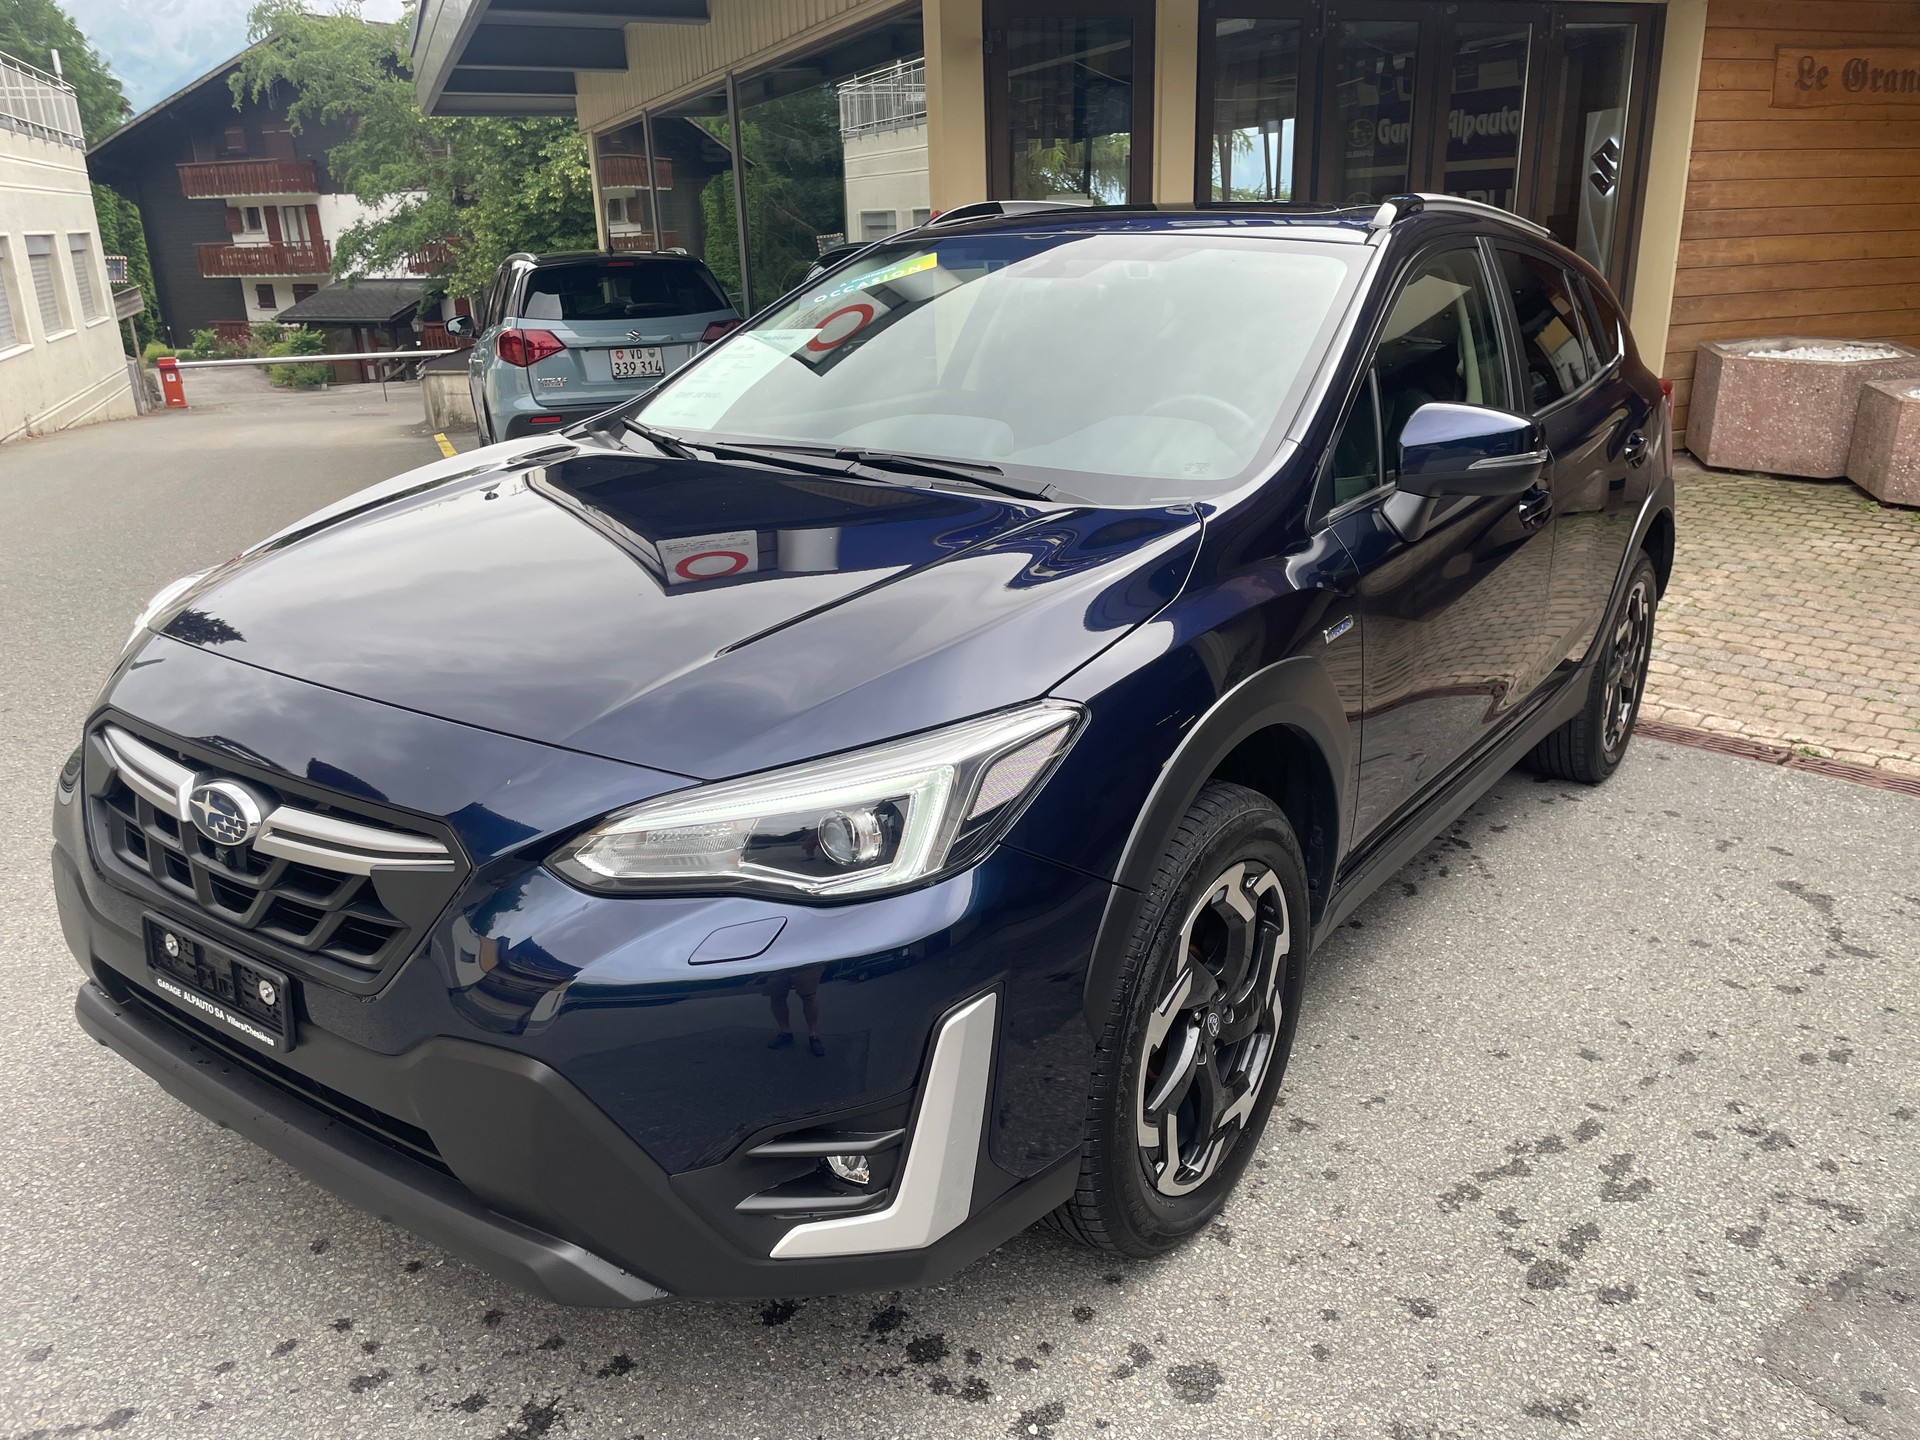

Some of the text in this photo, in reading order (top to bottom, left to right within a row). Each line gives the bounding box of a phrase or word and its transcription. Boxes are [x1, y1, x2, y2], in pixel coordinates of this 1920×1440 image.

[1795, 55, 1920, 93] Le Gran
[1377, 105, 1519, 146] Gar Alpauto
[1345, 149, 1375, 159] SUBARU
[813, 264, 921, 303] OCCASION
[614, 360, 662, 375] 339 314
[629, 349, 643, 359] VD
[157, 978, 182, 998] GARAGE
[183, 991, 214, 1015] ALPAUTO
[214, 1007, 226, 1020] SA
